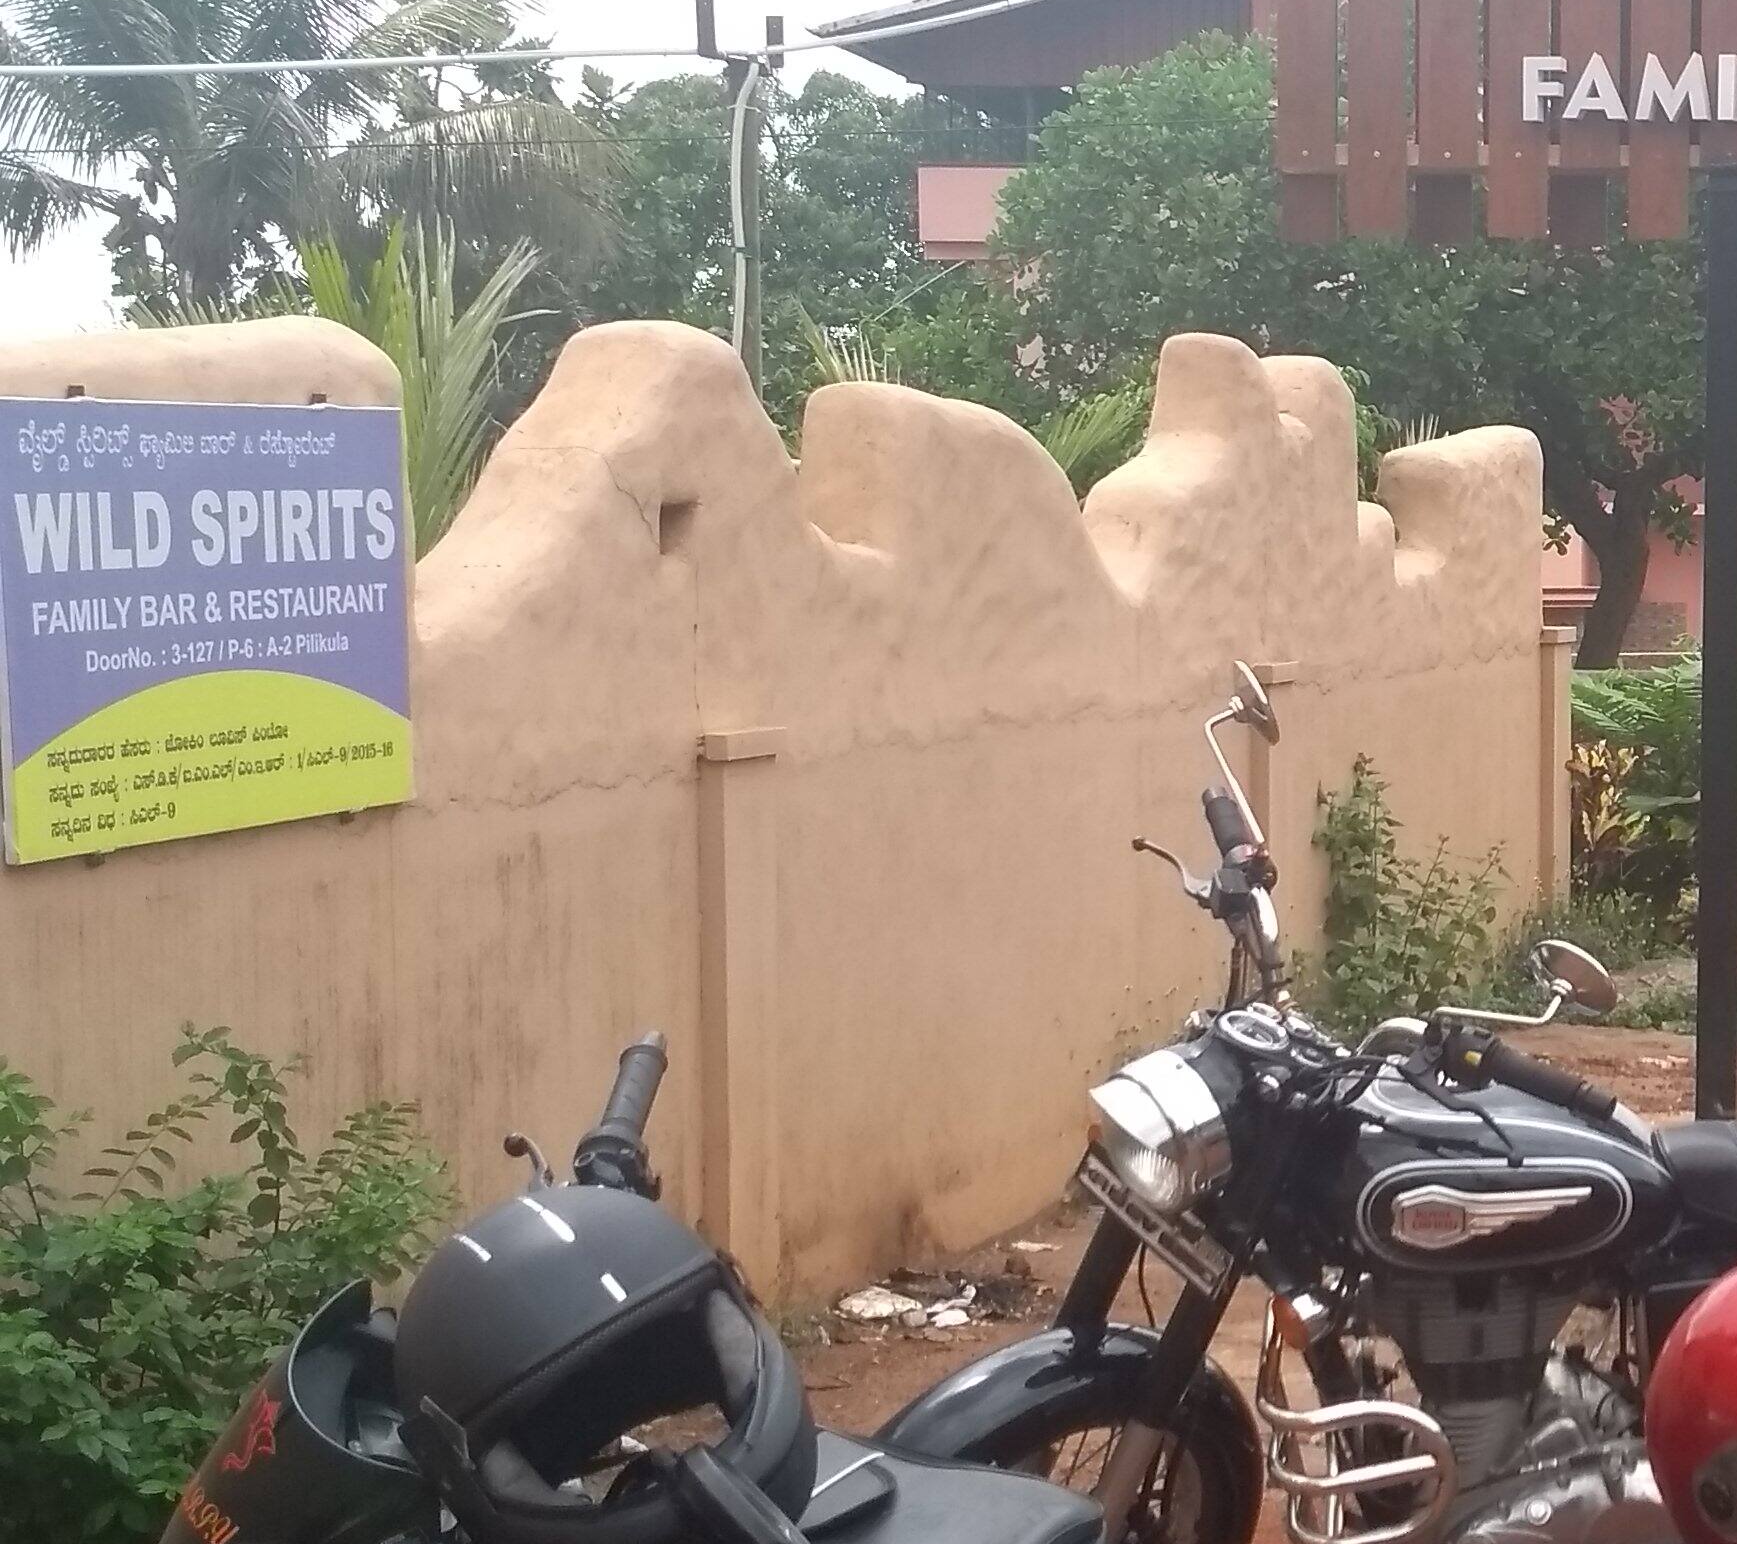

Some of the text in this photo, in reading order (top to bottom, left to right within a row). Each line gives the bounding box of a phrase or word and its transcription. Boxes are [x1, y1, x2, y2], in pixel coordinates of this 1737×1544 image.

[14, 488, 395, 574] WILD SPIRITS
[32, 583, 388, 635] FAMILY BAR & RESTAURANT
[86, 646, 156, 673] DoorNo.
[171, 641, 213, 665] 3-127
[228, 638, 253, 660] P-6
[267, 635, 291, 656] A-2
[296, 631, 349, 655] Pilikula
